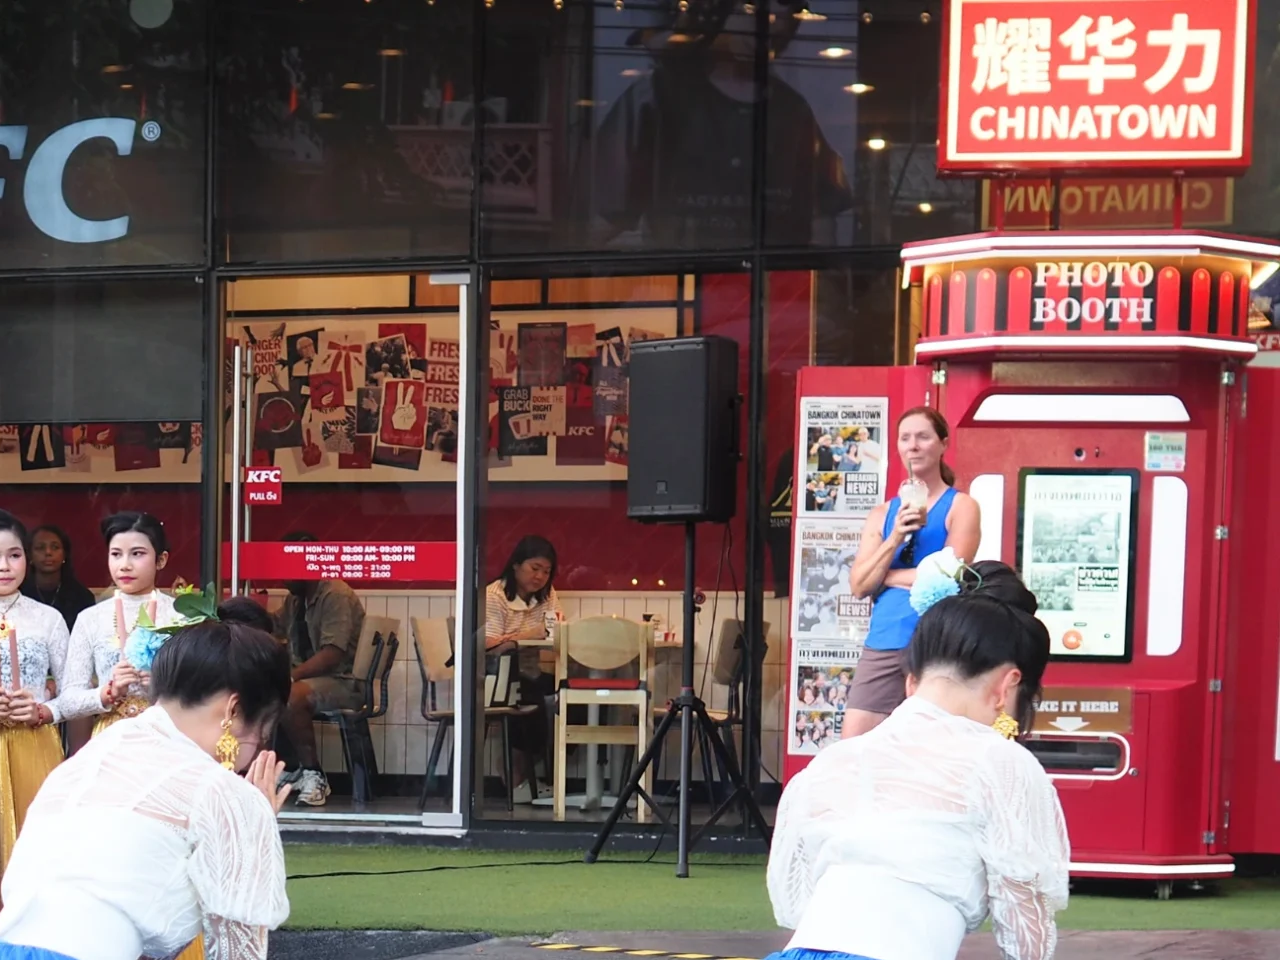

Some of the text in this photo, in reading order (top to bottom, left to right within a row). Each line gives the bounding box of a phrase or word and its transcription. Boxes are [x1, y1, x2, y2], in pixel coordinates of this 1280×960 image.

[972, 13, 1221, 95] 耀华力
[970, 104, 1217, 140] CHINATOWN
[1035, 262, 1154, 287] PHOTO
[1033, 297, 1154, 323] BOOTH
[503, 389, 528, 401] GRAB
[532, 396, 550, 404] DONE
[532, 404, 552, 413] RIGHT
[532, 413, 547, 421] WAY
[807, 410, 881, 420] BANGKOK CHINATOWN
[568, 426, 595, 436] KFC
[246, 470, 281, 483] KFC
[846, 482, 877, 494] NEWS!
[249, 492, 265, 501] PULL
[802, 532, 833, 540] BANGKOK
[283, 545, 304, 553] OPEN
[305, 545, 339, 553] MON-THU
[342, 545, 363, 553] 10:00
[403, 545, 415, 553] PM
[305, 554, 335, 562] FRI-SUN
[381, 554, 402, 562] 10:00
[403, 554, 415, 562] PM
[839, 604, 870, 616] NEWS!
[1061, 701, 1077, 712] IT
[1080, 701, 1119, 712] HERE
